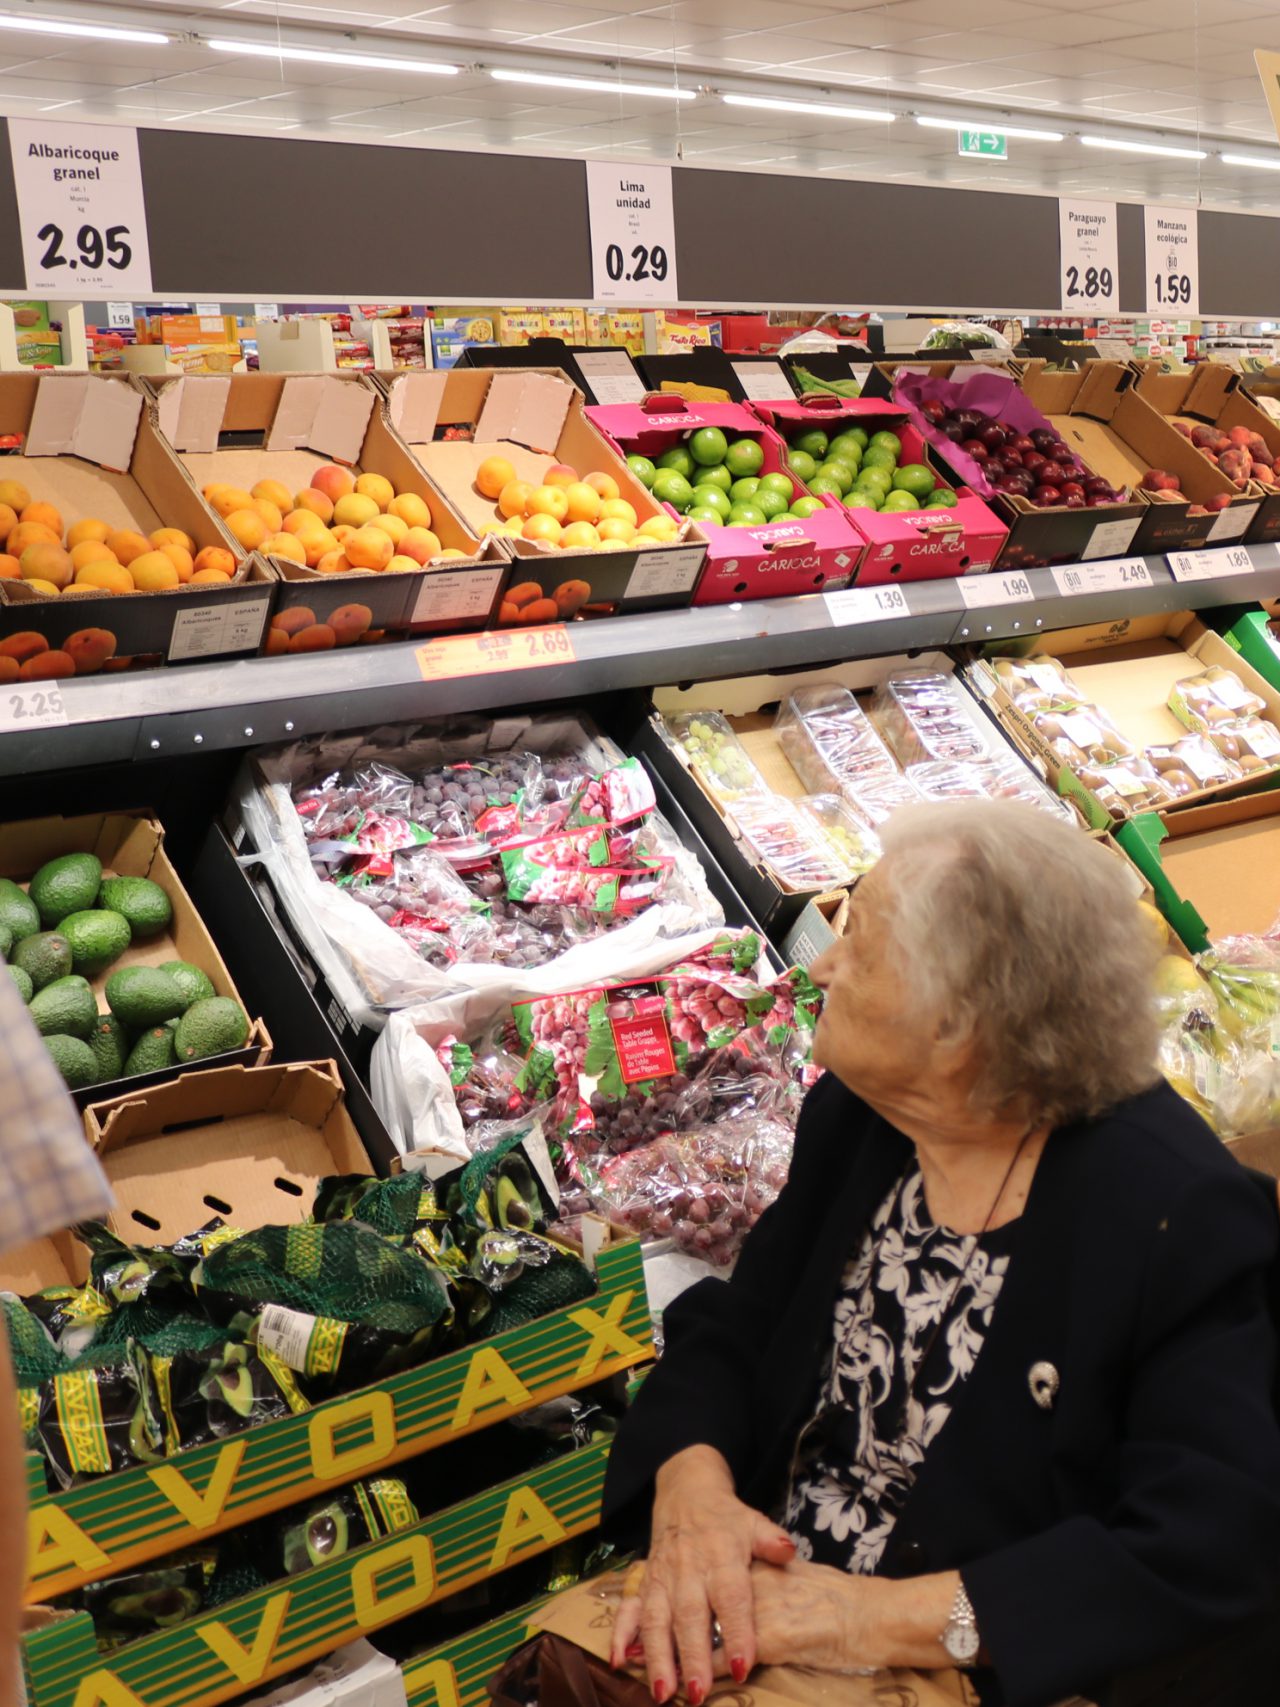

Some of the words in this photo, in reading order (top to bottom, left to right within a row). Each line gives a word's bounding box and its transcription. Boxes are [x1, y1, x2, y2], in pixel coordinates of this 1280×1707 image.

[28, 143, 120, 163] Albaricoque
[53, 167, 100, 181] granel
[620, 180, 645, 192] Lima
[616, 197, 651, 209] unidad
[1068, 211, 1107, 225] Paraguayo
[1157, 219, 1187, 231] Manzana
[1076, 227, 1099, 238] granel
[1156, 234, 1188, 244] ecológica
[37, 223, 132, 271] 2.95
[606, 244, 668, 281] 0.29
[1066, 265, 1113, 297] 2.89
[1155, 273, 1191, 303] 1.59
[113, 314, 130, 325] 1.59
[647, 415, 705, 426] CARIOCA
[757, 556, 822, 573] CARIOCA
[1227, 551, 1249, 568] 1.89
[1120, 564, 1147, 582] 2.49
[1002, 578, 1029, 596] 1.99
[874, 591, 904, 610] 1.39
[525, 631, 569, 657] 2.69
[9, 690, 64, 719] 2.25
[1005, 704, 1023, 726] Zespri
[1022, 722, 1047, 751] Organic
[1043, 747, 1061, 770] Green
[621, 1032, 632, 1040] Red
[633, 1028, 653, 1037] Seeded
[623, 1040, 637, 1048] Table
[644, 1047, 665, 1057] Rouges
[635, 1058, 650, 1066] Table
[63, 1376, 102, 1467] AVOAX
[27, 1290, 647, 1575] AVOAX
